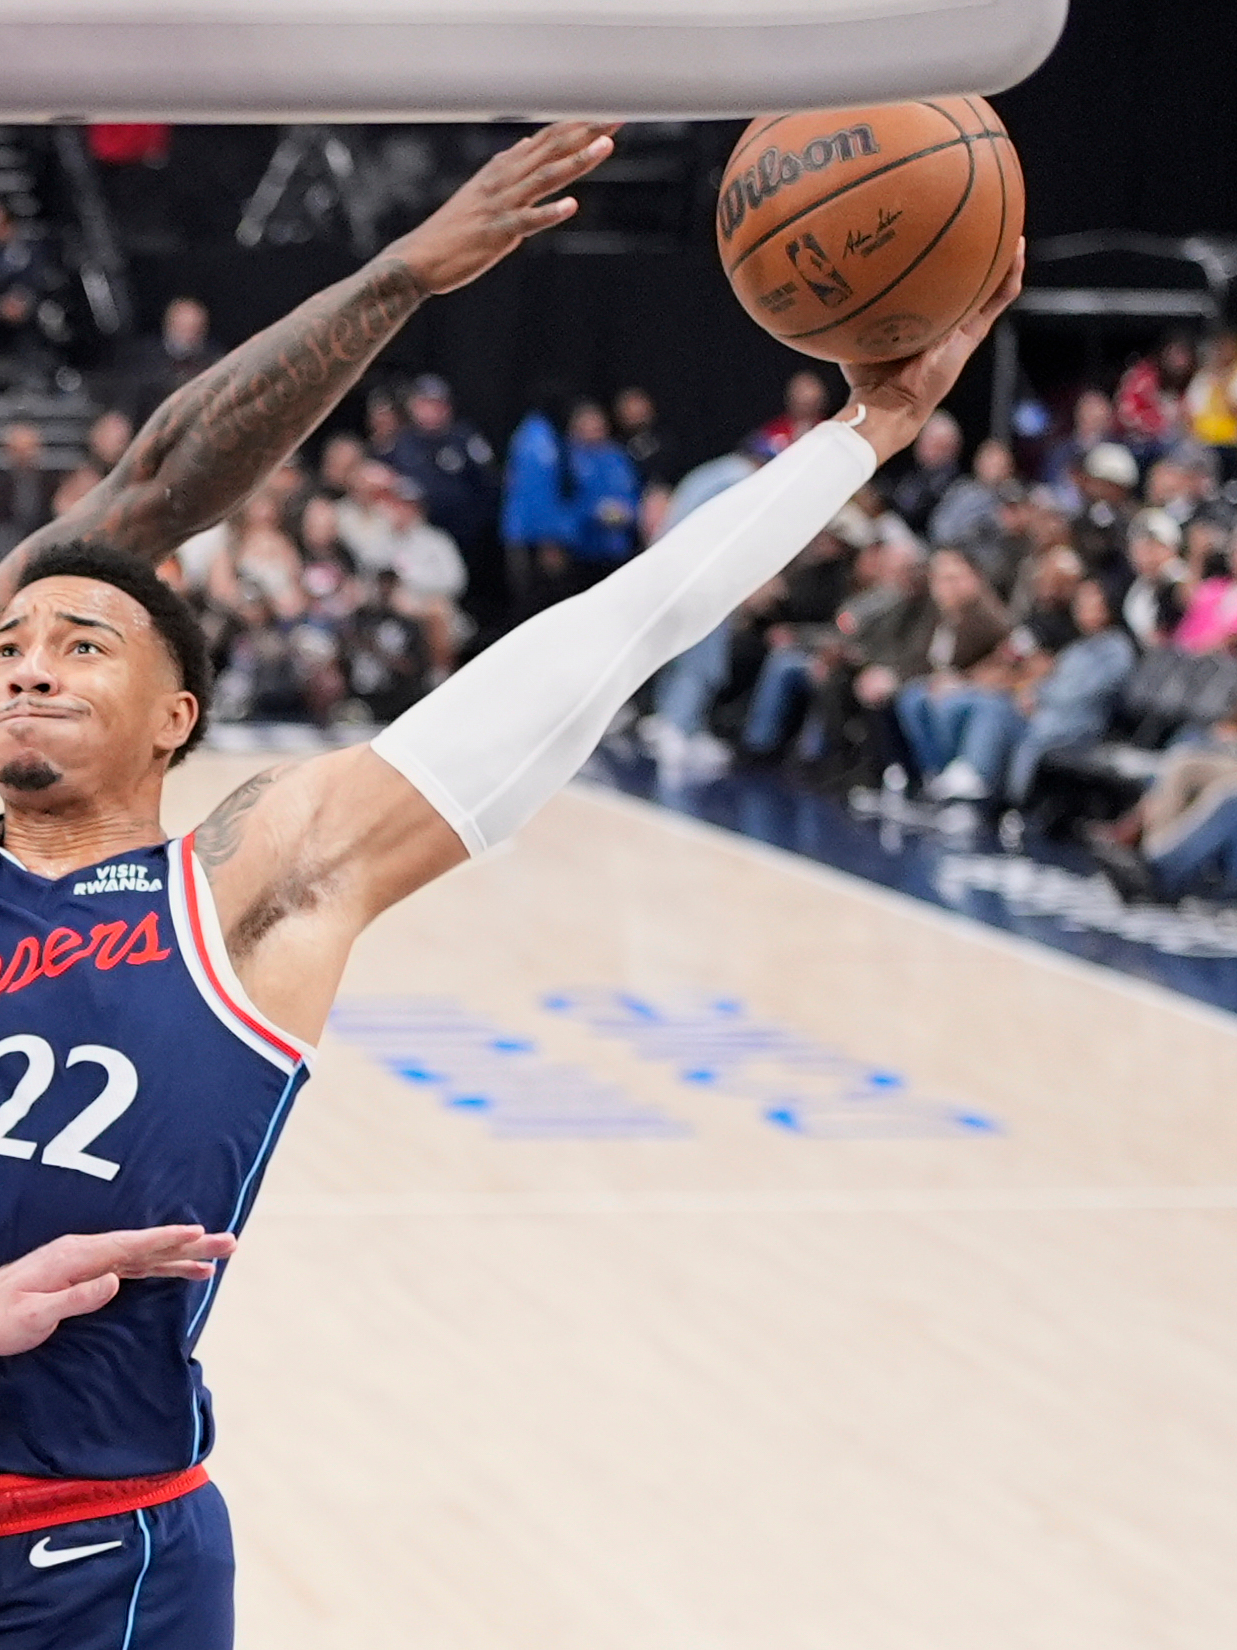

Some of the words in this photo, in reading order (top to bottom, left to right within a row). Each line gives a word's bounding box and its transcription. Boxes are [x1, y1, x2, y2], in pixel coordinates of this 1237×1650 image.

[717, 124, 880, 243] Wilson
[96, 864, 148, 880] VISIT
[73, 878, 163, 895] RWANDA
